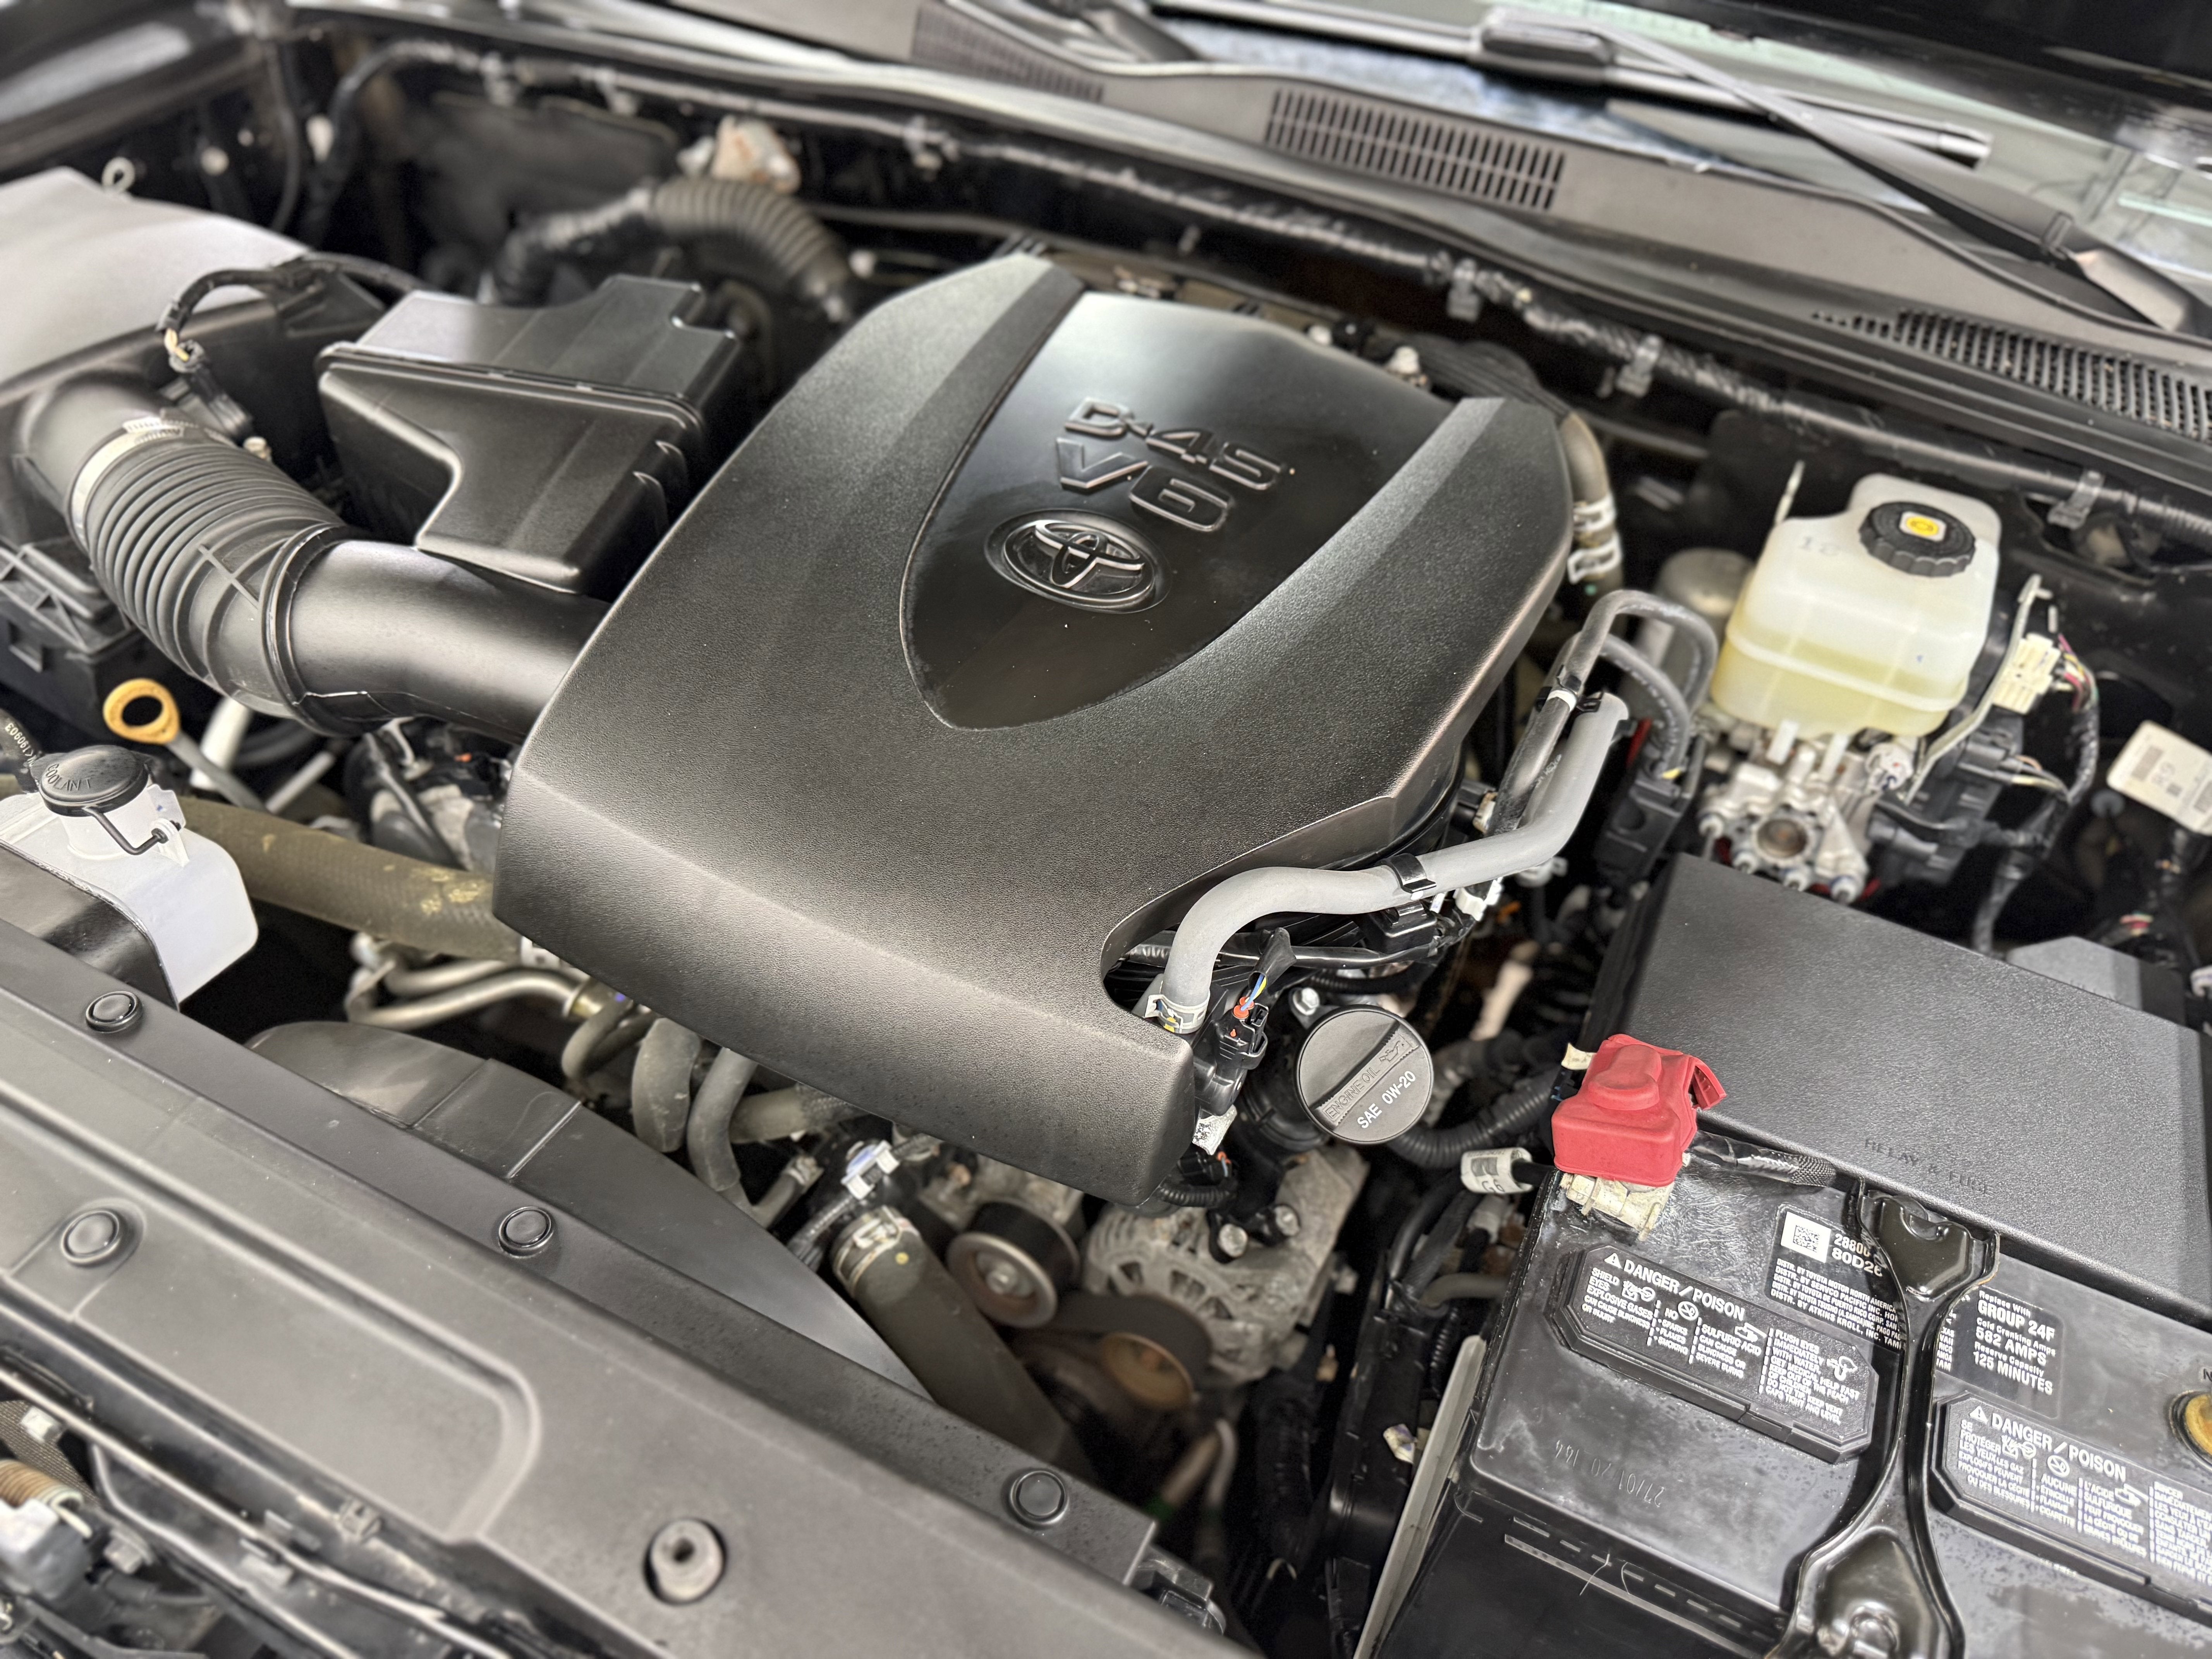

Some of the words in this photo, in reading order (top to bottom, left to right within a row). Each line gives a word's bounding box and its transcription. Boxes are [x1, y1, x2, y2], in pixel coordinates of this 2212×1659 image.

[1056, 437, 1235, 532] V6
[46, 764, 91, 792] COOLANT
[1324, 1080, 1365, 1118] ENGINE
[1362, 1067, 1380, 1083] OIL
[1357, 1103, 1382, 1128] SAE
[1382, 1071, 1416, 1104] 0W-20
[1865, 1137, 1918, 1166] RELAY
[1589, 1275, 1611, 1292] EYES
[1591, 1266, 1620, 1286] SHIELD
[1623, 1259, 1680, 1294] DANGER
[1692, 1288, 1745, 1322] POISON
[1775, 1265, 1800, 1282] DISTR.
[1800, 1275, 1810, 1286] BY
[1810, 1279, 1839, 1299] SERVCO
[1839, 1291, 1867, 1310] PACIFIC
[1868, 1304, 1883, 1316] INC.
[1776, 1257, 1796, 1272] DISTR.
[1796, 1266, 1805, 1276] BY
[1805, 1269, 1828, 1285] TOYOTA
[1827, 1279, 1850, 1295] MOTOR
[1849, 1288, 1870, 1303] NORTH
[1581, 1302, 1592, 1314] OR
[1592, 1307, 1616, 1324] INJURY
[1583, 1294, 1597, 1306] CAN
[1597, 1300, 1618, 1316] CAUSE
[1617, 1309, 1651, 1330] BLINDNESS
[1586, 1284, 1628, 1310] EXPLOSIVE
[1626, 1301, 1654, 1321] GASES
[1664, 1307, 1679, 1321] NO
[1770, 1288, 1796, 1305] DISTR.
[1796, 1299, 1808, 1310] BY
[1808, 1304, 1836, 1323] ATKINS
[1865, 1328, 1881, 1341] INC.
[1773, 1273, 1792, 1287] DISTR.
[1792, 1281, 1801, 1290] BY
[1800, 1284, 1822, 1300] TOYOTA
[1822, 1293, 1831, 1303] DE
[1831, 1296, 1853, 1312] PUERTO
[1853, 1306, 1867, 1318] RICO
[1867, 1312, 1884, 1326] CORP.
[1885, 1320, 1897, 1330] SAN
[1789, 1288, 1798, 1297] BY
[1796, 1290, 1817, 1306] TOYOTA
[1816, 1299, 1838, 1315] TSUSHO
[1876, 1324, 1891, 1336] PAGO
[1978, 1290, 2010, 1310] Replace
[2012, 1303, 2031, 1318] With
[1661, 1318, 1688, 1336] SPARKS
[1977, 1298, 2025, 1331] GROUP
[2027, 1319, 2055, 1343] 24F
[1657, 1336, 1689, 1356] SMOKING
[1659, 1327, 1686, 1345] FLAMES
[1698, 1334, 1714, 1347] CAN
[1714, 1340, 1737, 1357] CAUSE
[1701, 1323, 1742, 1348] SULFURIC
[1740, 1340, 1762, 1357] ACID
[1774, 1329, 1800, 1346] FLUSH
[1799, 1339, 1820, 1355] EYES
[1975, 1325, 2002, 1348] 582
[2004, 1338, 2047, 1367] AMPS
[1976, 1317, 1994, 1331] Cold
[1996, 1325, 2031, 1347] Cranking
[2033, 1340, 2056, 1358] Amps
[1695, 1352, 1721, 1369] SEVERE
[1720, 1362, 1744, 1379] BURNS
[1697, 1343, 1734, 1365] BLINDNESS
[1734, 1358, 1746, 1370] OR
[1771, 1346, 1792, 1361] WITH
[1773, 1338, 1824, 1366] IMMEDIATELY
[1974, 1341, 2007, 1362] Reserve
[2008, 1355, 2044, 1378] Capacity
[1767, 1370, 1779, 1381] OF
[1769, 1363, 1787, 1377] KEEP
[1786, 1370, 1802, 1383] OUT
[1801, 1377, 1812, 1388] OF
[1812, 1382, 1826, 1395] THE
[1826, 1388, 1849, 1405] REACH
[1770, 1355, 1786, 1369] GET
[1787, 1362, 1819, 1382] MEDICAL
[1819, 1376, 1839, 1391] HELP
[1839, 1384, 1860, 1401] FAST
[1972, 1350, 1994, 1371] 125
[1997, 1360, 2053, 1396] MINUTES
[1765, 1385, 1784, 1400] CAPS
[1784, 1393, 1804, 1408] TIGHT
[1805, 1402, 1820, 1415] AND
[1819, 1408, 1842, 1425] LEVEL
[1767, 1377, 1778, 1388] DO
[1778, 1382, 1793, 1395] NOT
[1806, 1395, 1824, 1409] KEEP
[1824, 1402, 1843, 1417] VENT
[1961, 1419, 1973, 1432] SE
[1959, 1439, 1975, 1455] LES
[1975, 1446, 1996, 1464] YEUX
[1991, 1412, 2052, 1453] DANGER
[2068, 1443, 2126, 1484] POISON
[1958, 1450, 1993, 1472] EXPLOSIFS
[1994, 1465, 2023, 1486] PEUVENT
[1958, 1460, 1997, 1486] PROVOQUER
[1997, 1477, 2007, 1489] LA
[1996, 1456, 2009, 1469] LES
[2010, 1462, 2024, 1475] GAZ
[1967, 1474, 1978, 1487] OU
[1978, 1479, 1992, 1493] DES
[1993, 1485, 2030, 1510] BLESSURES
[2041, 1472, 2077, 1498] AUCUNE
[2084, 1479, 2115, 1502] L'ACIDE
[2039, 1494, 2068, 1514] FLAMME
[2039, 1504, 2076, 1529] CIGARETTE
[2083, 1490, 2133, 1521] SULFURIQUE
[2154, 1499, 2169, 1514] LES
[2083, 1513, 2093, 1525] LA
[2084, 1502, 2102, 1519] PEUT
[2102, 1510, 2144, 1536] PROVOQUER
